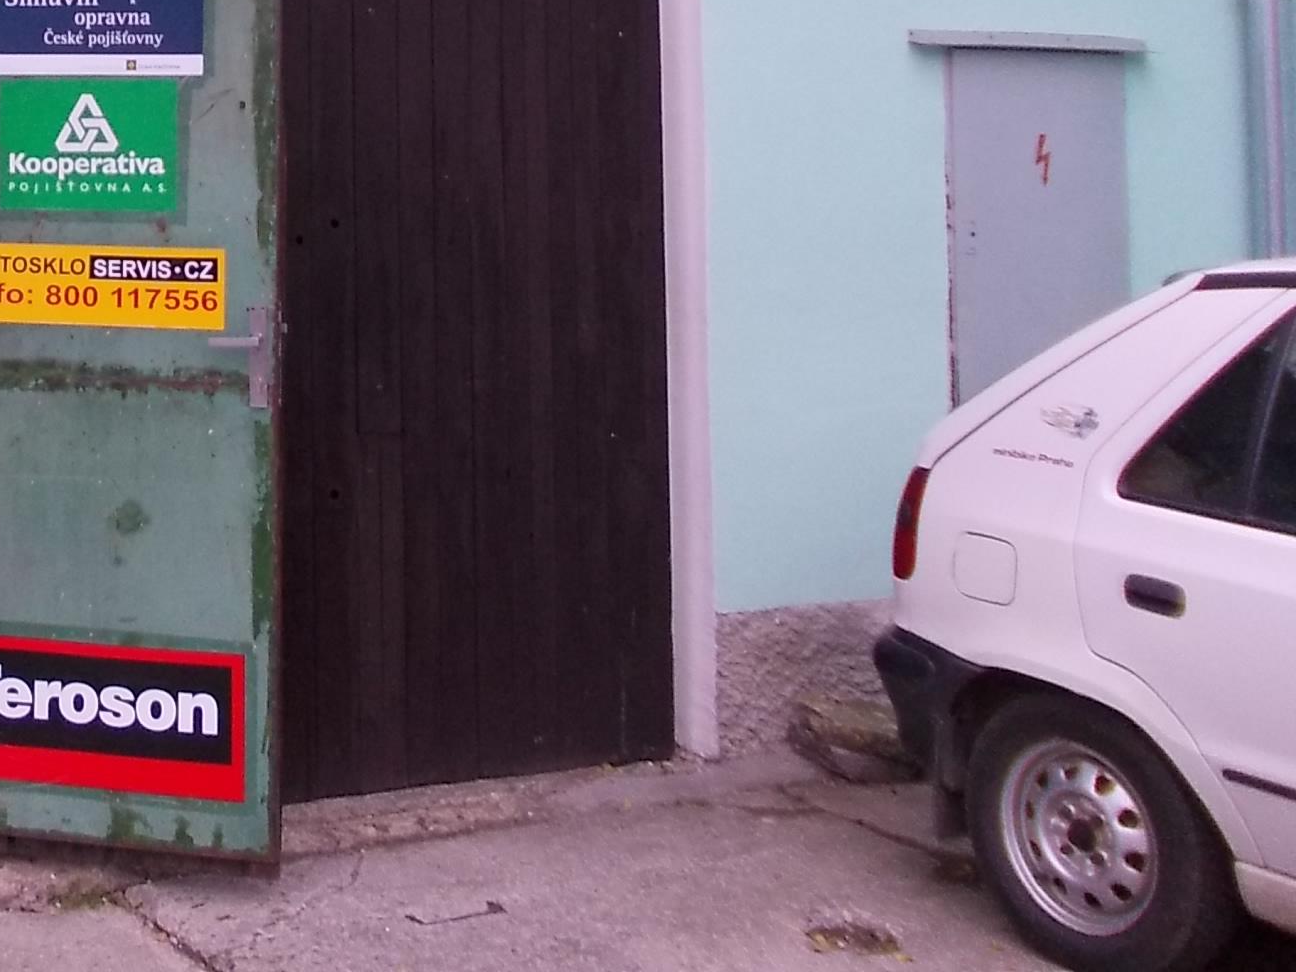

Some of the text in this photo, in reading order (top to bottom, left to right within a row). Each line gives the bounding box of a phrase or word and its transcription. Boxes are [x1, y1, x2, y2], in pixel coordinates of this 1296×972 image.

[74, 11, 151, 30] opravna
[43, 28, 164, 48] České pojišťovny
[9, 151, 166, 181] Kooperativa
[45, 284, 99, 307] 800
[111, 287, 219, 312] 117556
